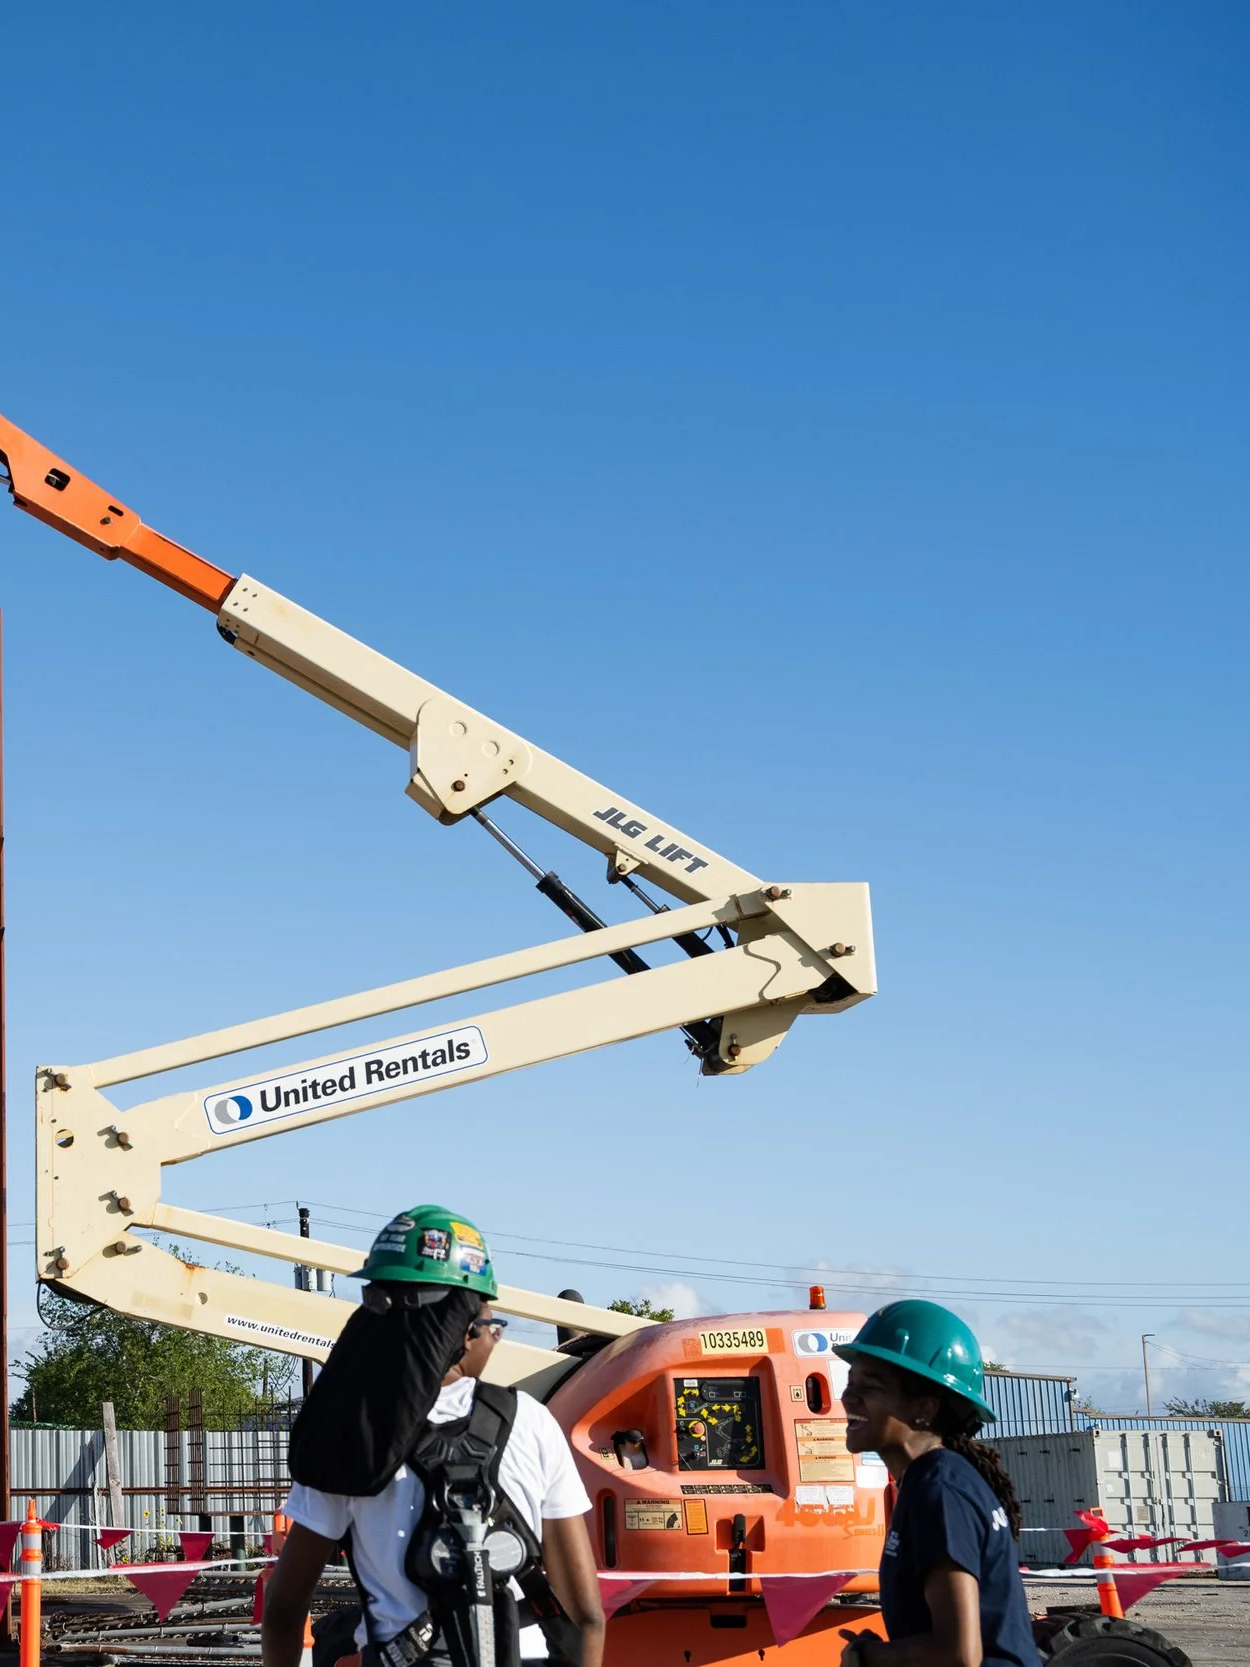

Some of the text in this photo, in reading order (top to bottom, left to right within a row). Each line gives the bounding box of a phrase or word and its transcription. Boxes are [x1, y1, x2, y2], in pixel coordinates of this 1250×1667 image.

[593, 807, 709, 873] JLG LIFT
[259, 1039, 471, 1112] United Rentals
[227, 1316, 336, 1349] www.unitedrentals
[700, 1330, 764, 1349] 10335489
[830, 1332, 853, 1342] Unit
